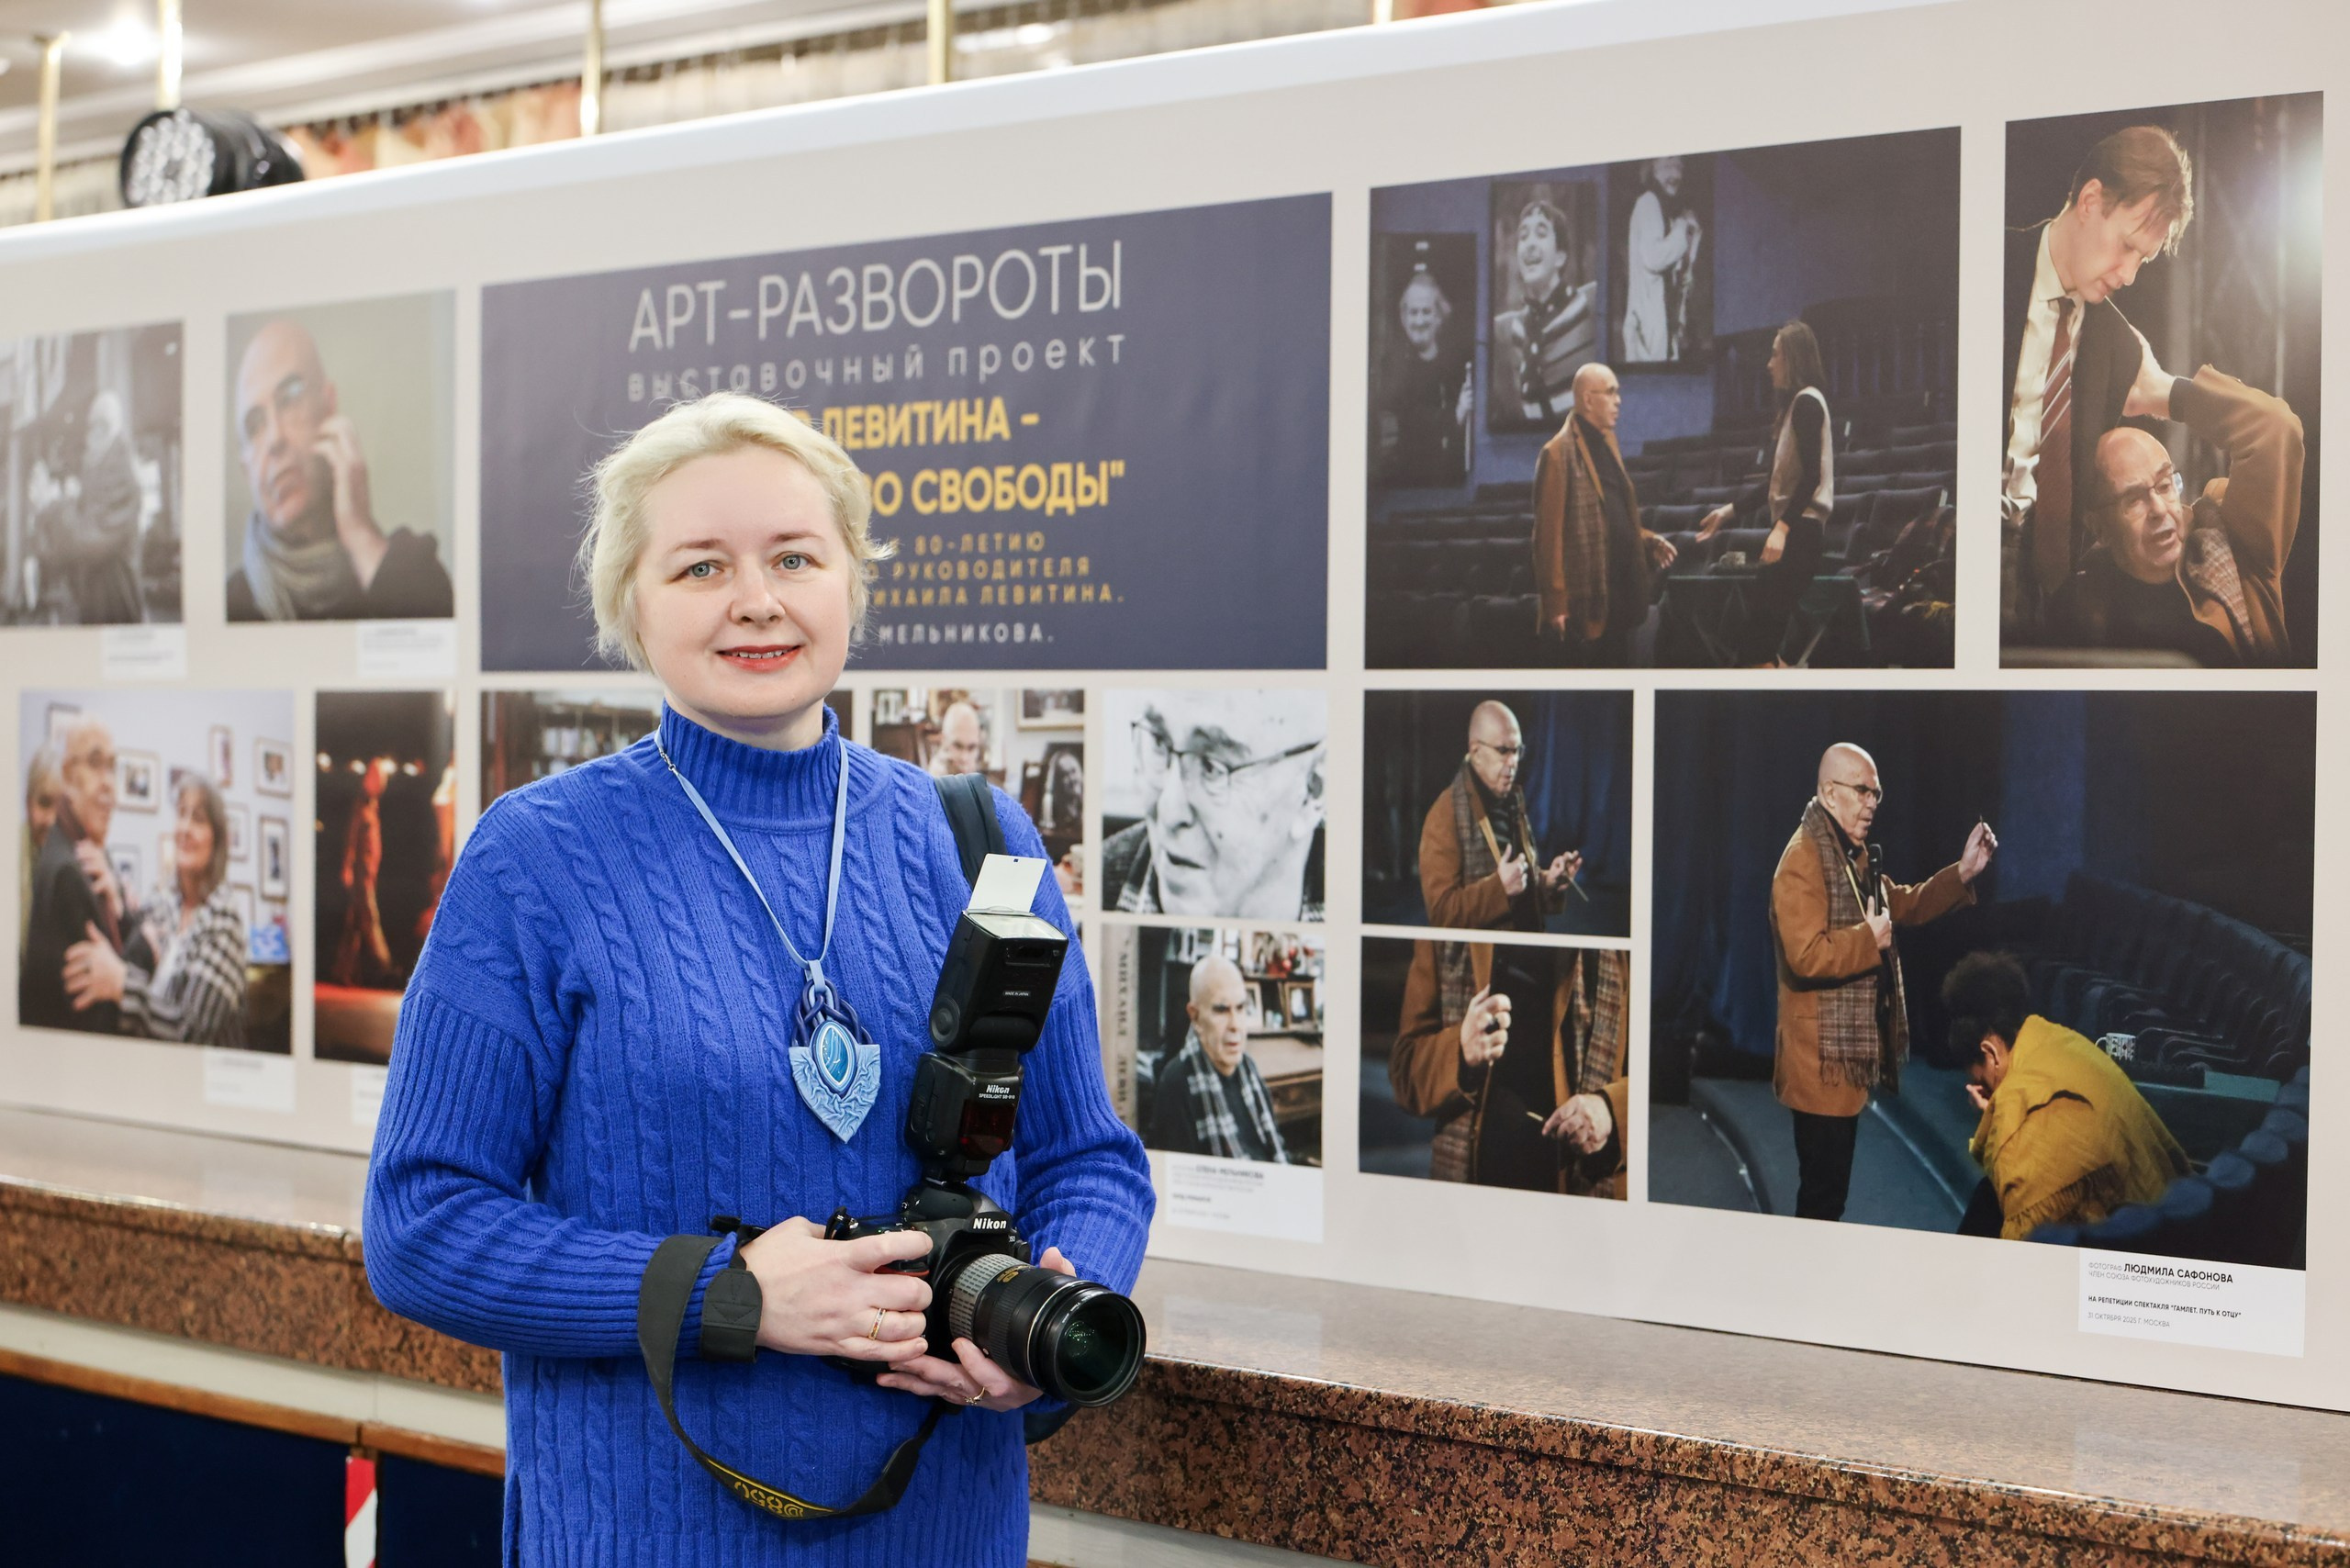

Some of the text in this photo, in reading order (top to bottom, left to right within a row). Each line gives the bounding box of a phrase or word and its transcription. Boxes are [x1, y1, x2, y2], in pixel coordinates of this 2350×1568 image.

[630, 241, 1122, 353] АРТ-РАЗВОРОТЫ
[949, 333, 1125, 383] проект
[911, 460, 1125, 516] СВОБОДЫ"
[914, 531, 1046, 555] 80-ЛЕТИЮ
[980, 584, 1125, 606] ЛЕВИТИНА.
[986, 1084, 1011, 1093] Nikon
[973, 1217, 1007, 1229] Nikon
[2088, 1262, 2233, 1283] ФОТОГРАФ ЛЮДМИЛА САФОНОВА
[2106, 1272, 2130, 1281] СОЮЗА
[2192, 1282, 2220, 1290] РОССИИ
[2098, 1296, 2133, 1305] РЕПЕТИЦИИ
[2133, 1301, 2169, 1310] СПЕКТАКЛЯ
[2199, 1307, 2215, 1316] ПУТЬ
[2094, 1313, 2121, 1321] ОКТЯБРЯ
[2122, 1316, 2137, 1324] 2025
[2143, 1318, 2170, 1327] МОСКВА
